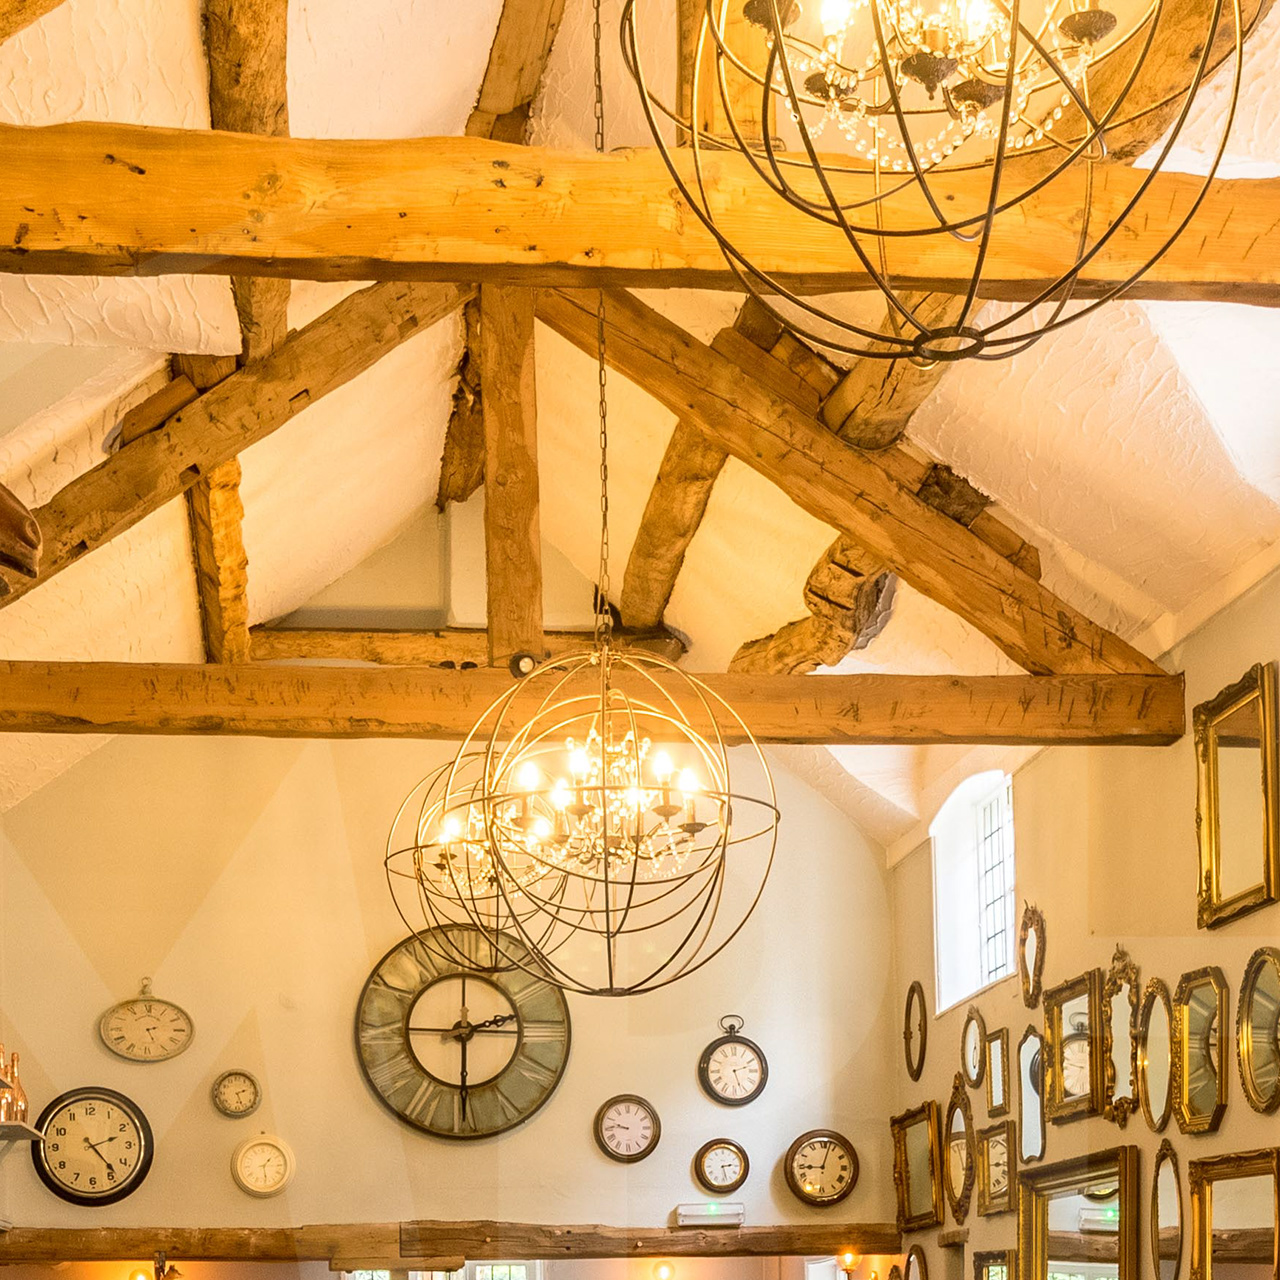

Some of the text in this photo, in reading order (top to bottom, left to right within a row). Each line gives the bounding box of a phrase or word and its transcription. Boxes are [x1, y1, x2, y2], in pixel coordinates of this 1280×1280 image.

[85, 1107, 96, 1116] 12
[69, 1112, 76, 1121] 11
[56, 1127, 67, 1136] 10
[119, 1123, 127, 1132] 2
[51, 1143, 59, 1152] 9
[125, 1140, 133, 1150] 3
[58, 1160, 66, 1169] 8
[73, 1172, 80, 1181] 7
[89, 1176, 97, 1186] 6
